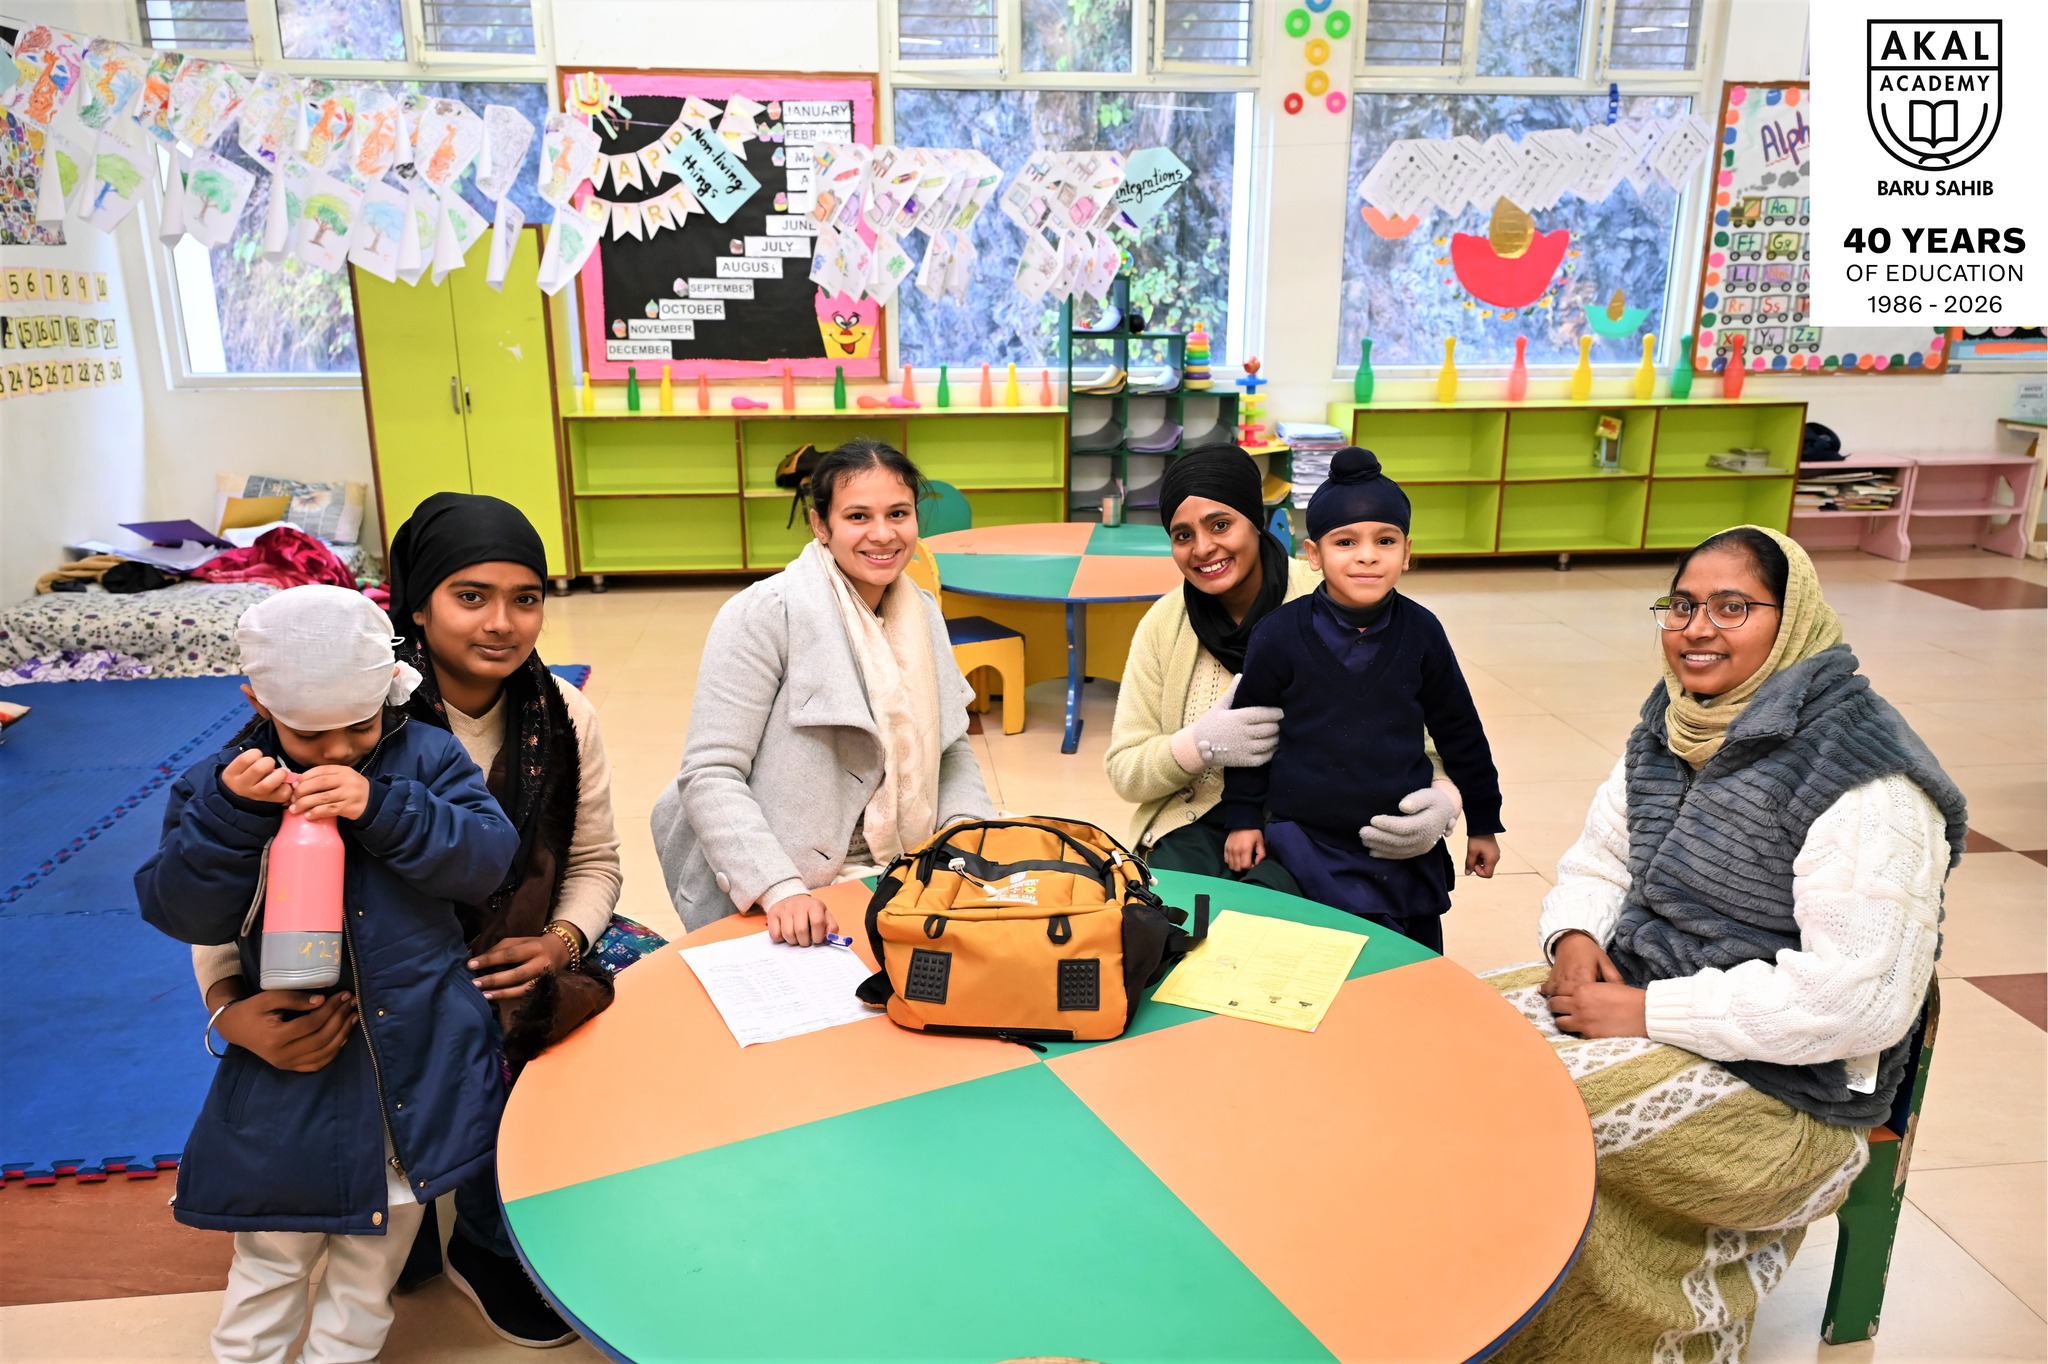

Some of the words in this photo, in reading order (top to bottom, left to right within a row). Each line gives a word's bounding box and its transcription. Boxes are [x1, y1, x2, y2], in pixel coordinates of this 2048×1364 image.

[691, 127, 746, 195] Non-living
[682, 153, 719, 199] things
[762, 241, 794, 252] JULY
[9, 274, 19, 295] 5
[27, 272, 36, 292] 6
[45, 274, 53, 294] 7
[61, 274, 70, 296] 8
[78, 276, 87, 298] 9
[97, 277, 107, 297] 10
[661, 304, 723, 315] OCTOBER
[18, 321, 33, 343] 15
[35, 321, 49, 342] 16
[50, 320, 62, 341] 17
[70, 322, 80, 342] 18
[85, 322, 97, 345] 19
[104, 325, 115, 344] 20
[630, 325, 692, 334] NOVEMBER
[609, 345, 670, 355] DECEMBER
[8, 370, 23, 391] 24
[27, 367, 43, 388] 25
[45, 365, 59, 385] 26
[62, 364, 74, 384] 27
[78, 363, 90, 382] 28
[94, 363, 106, 382] 29
[110, 361, 121, 380] 30
